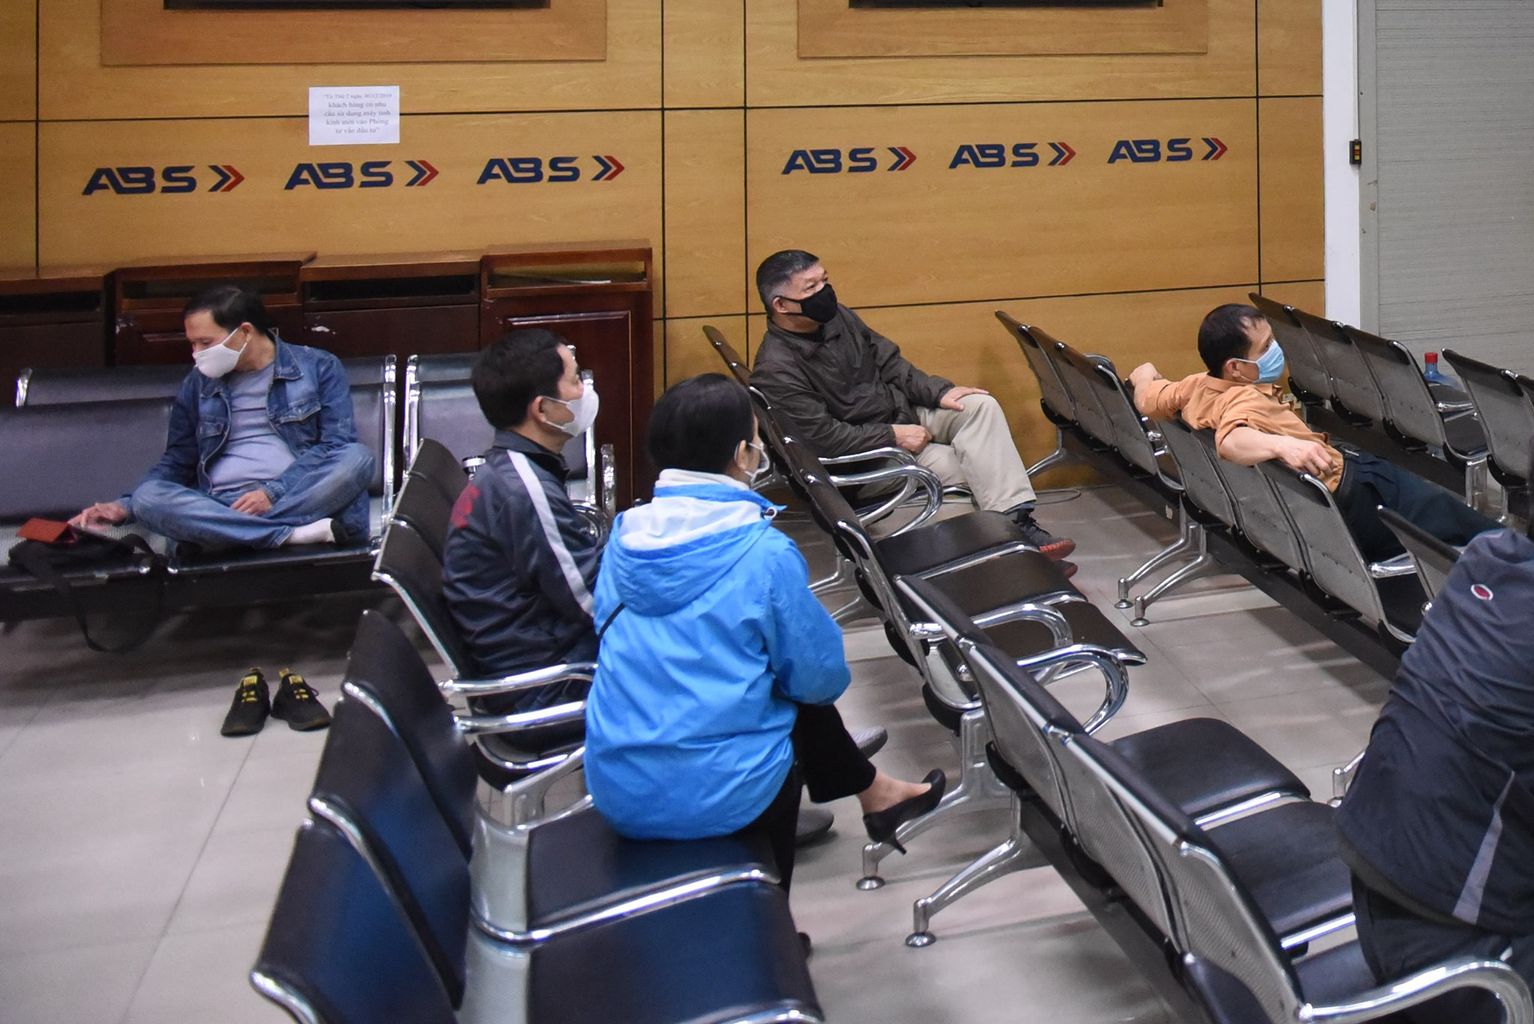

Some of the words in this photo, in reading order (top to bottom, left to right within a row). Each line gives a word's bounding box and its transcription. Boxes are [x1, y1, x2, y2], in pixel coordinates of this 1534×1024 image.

[781, 147, 878, 175] ABS
[948, 142, 1039, 169] ABS
[1106, 138, 1194, 164] ABS
[81, 165, 197, 195] ABS
[284, 160, 394, 190] ABS
[476, 157, 581, 184] ABS
